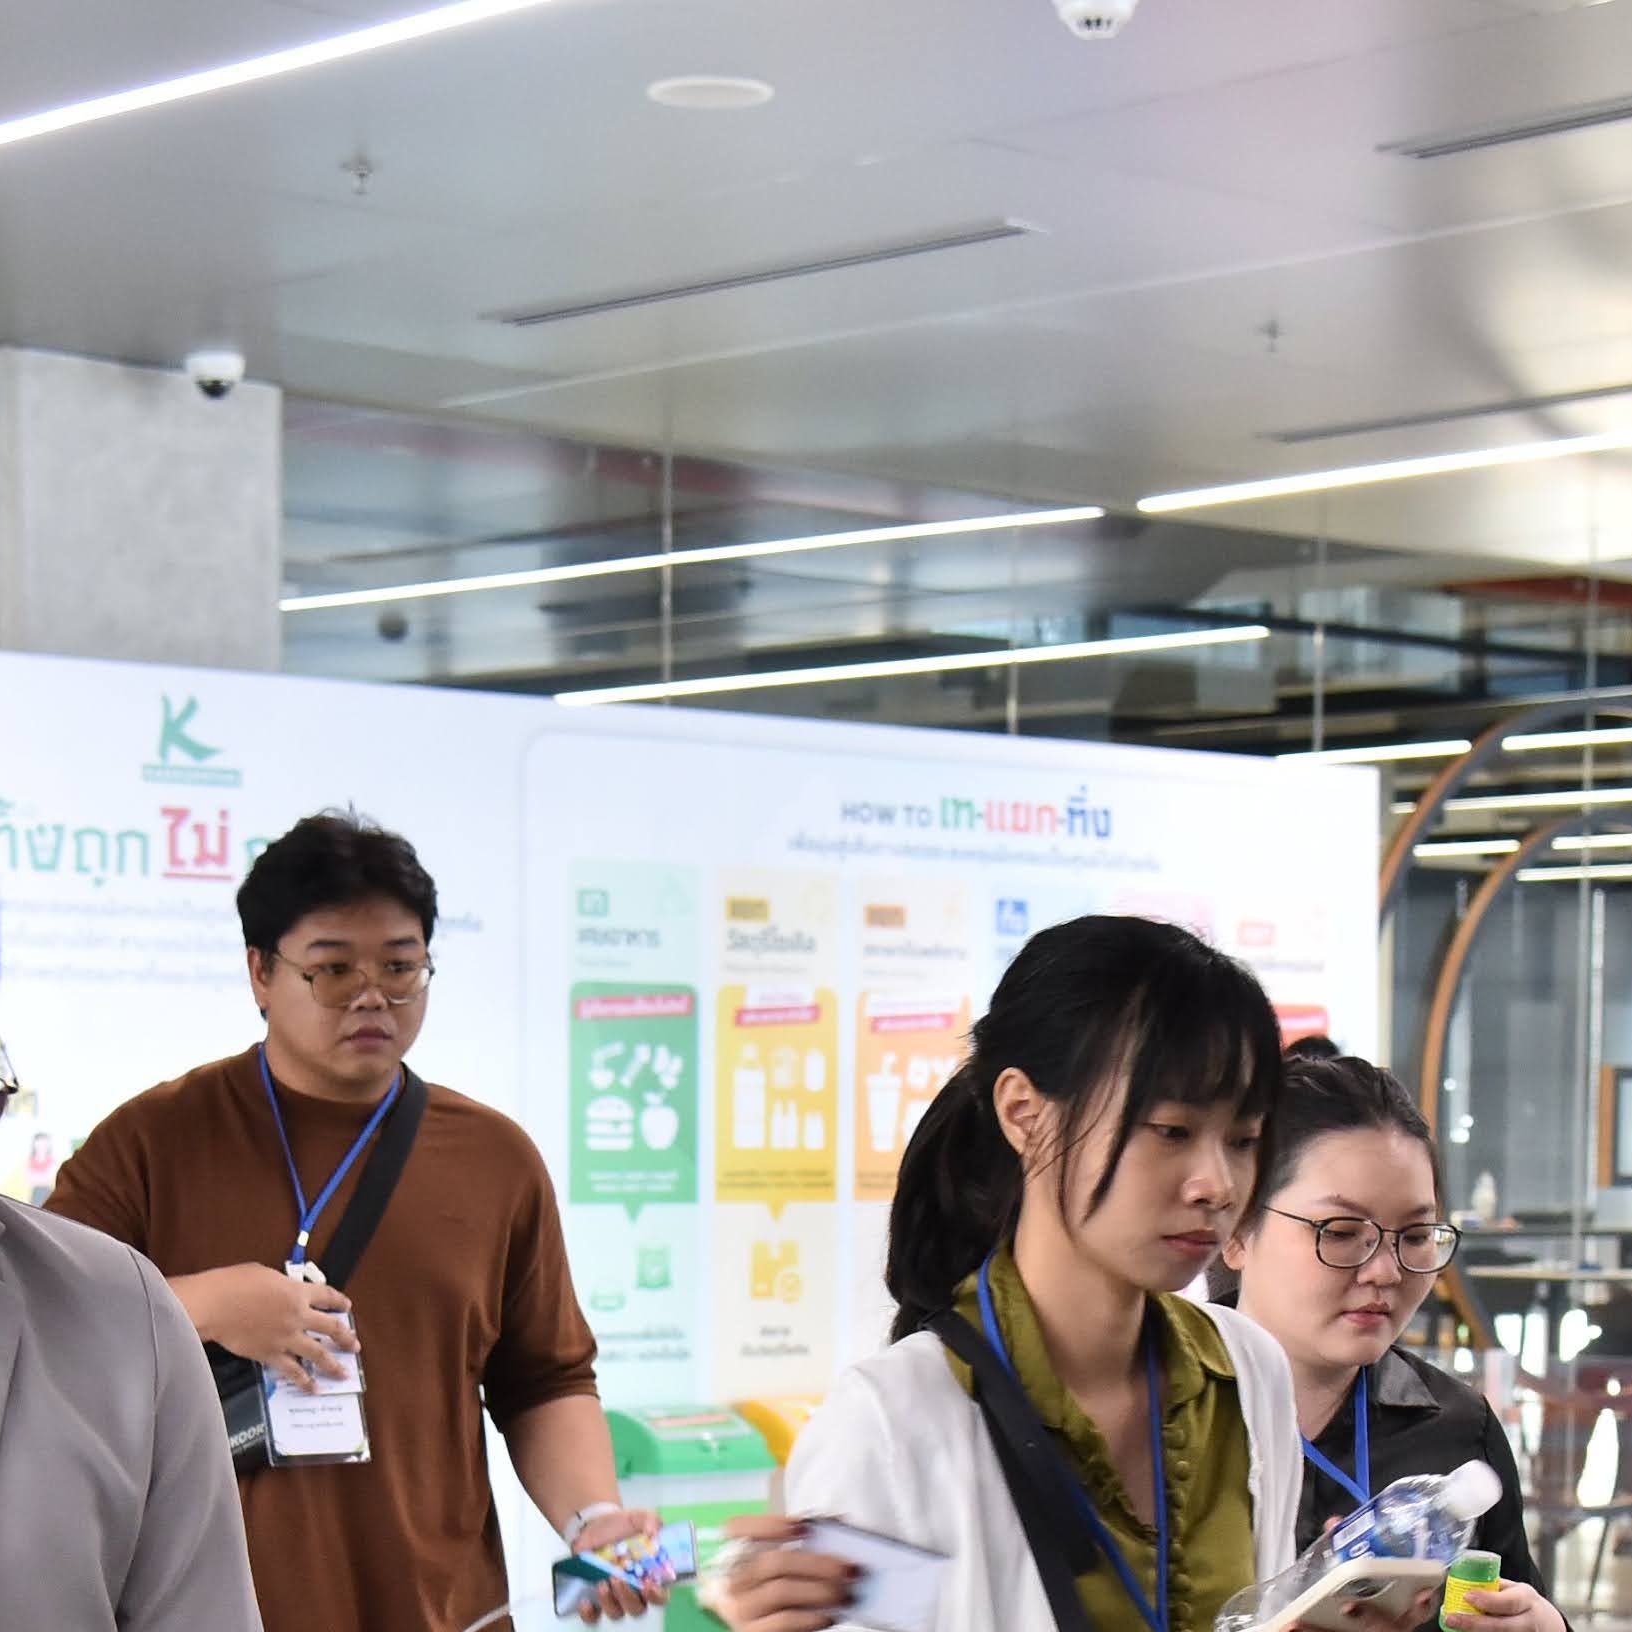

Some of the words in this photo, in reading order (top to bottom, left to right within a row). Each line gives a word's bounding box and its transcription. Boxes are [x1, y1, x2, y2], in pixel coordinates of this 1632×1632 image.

[841, 801, 896, 827] HOW
[902, 803, 933, 828] TO
[159, 807, 230, 868] ไม่
